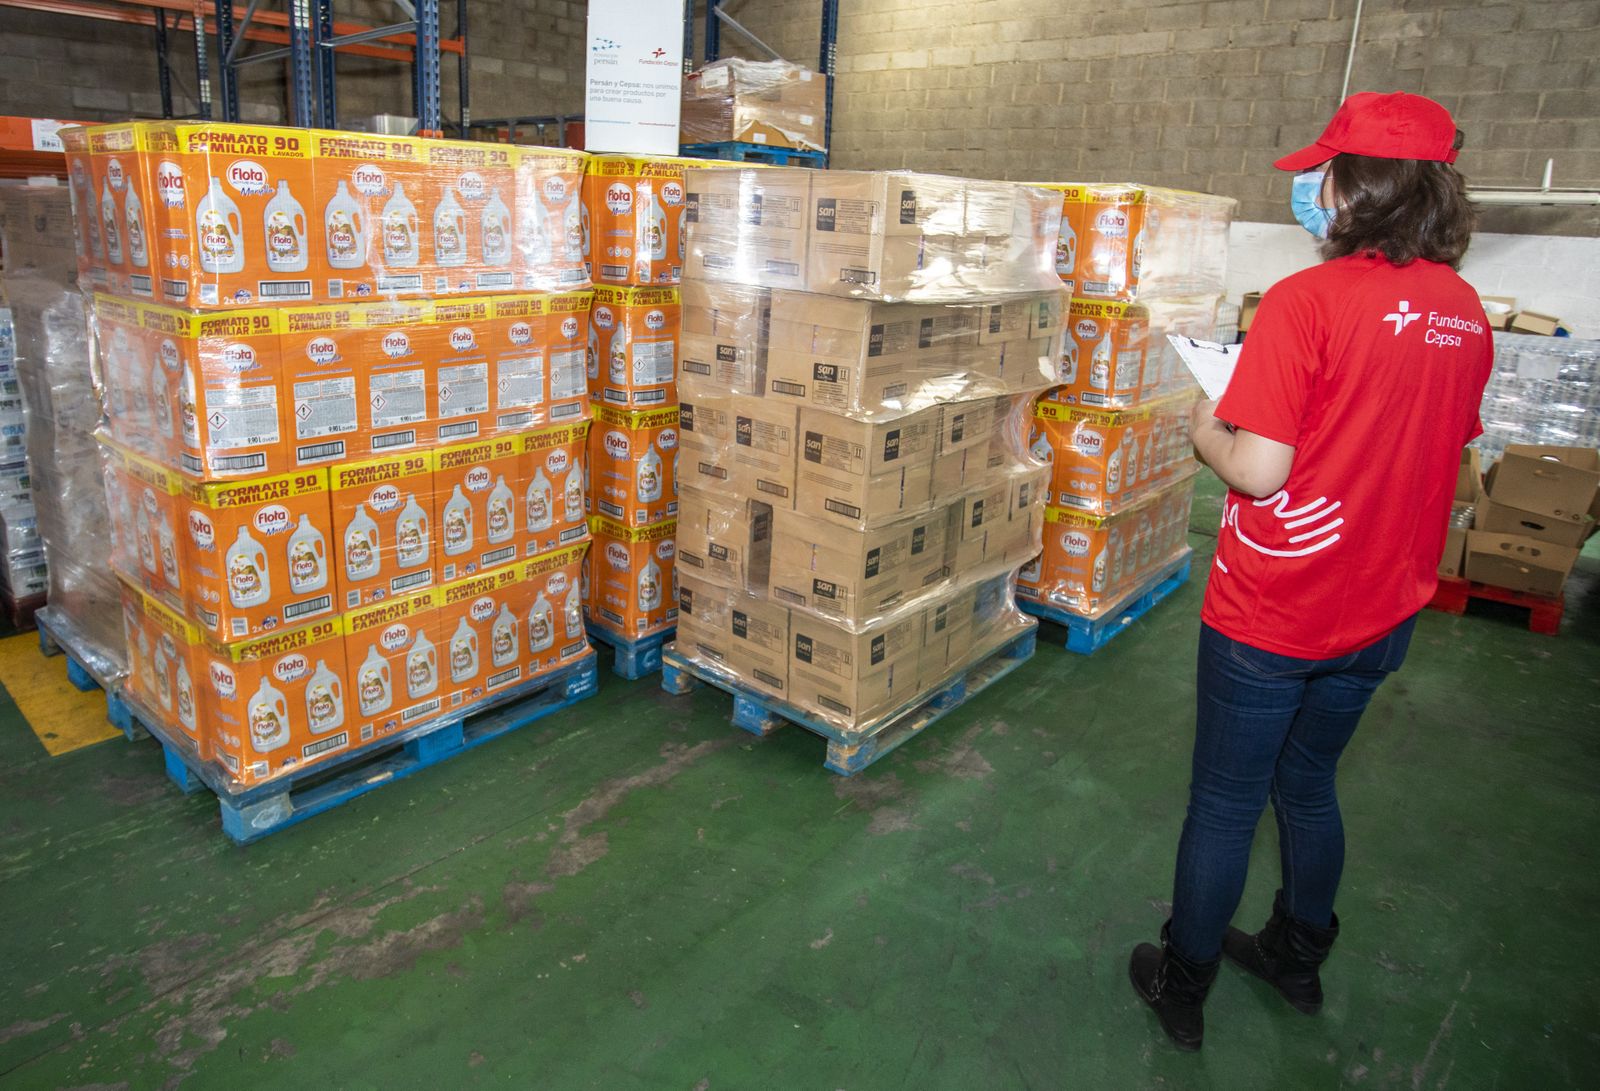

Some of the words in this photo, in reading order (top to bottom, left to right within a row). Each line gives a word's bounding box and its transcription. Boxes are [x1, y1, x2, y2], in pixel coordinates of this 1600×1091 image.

[603, 95, 621, 103] buena
[189, 132, 268, 145] FORMATO
[274, 137, 299, 151] 90
[319, 138, 386, 150] FORMATO
[391, 143, 412, 155] 90
[189, 143, 267, 155] FAMILIAR
[490, 151, 507, 162] 90
[232, 168, 262, 181] Flota
[357, 172, 382, 183] Flota
[460, 178, 482, 188] Flota
[608, 190, 630, 201] Flota
[664, 187, 680, 196] Flota
[1065, 189, 1079, 198] 90
[902, 200, 915, 209] san
[818, 207, 834, 217] san
[274, 235, 292, 245] Flota
[633, 291, 661, 300] FORMATO
[663, 291, 673, 300] 90
[496, 301, 529, 310] FORMATO
[531, 301, 542, 310] 90
[551, 297, 579, 306] FORMATO
[580, 297, 589, 306] 90
[474, 304, 485, 314] 90
[496, 308, 528, 316] FAMILIAR
[1106, 306, 1121, 314] 90
[288, 312, 331, 322] FORMATO
[335, 311, 349, 322] 90
[435, 312, 470, 321] FAMILIAR
[201, 317, 249, 329] FORMATO
[253, 316, 269, 328] 90
[289, 322, 332, 332] FAMILIAR
[1078, 323, 1096, 332] Flota
[1428, 311, 1483, 335] Fundación
[201, 326, 249, 336] FAMILIAR
[453, 332, 471, 341] Flota
[511, 328, 529, 337] Flota
[385, 338, 406, 347] Flota
[1425, 329, 1462, 348] Cepsa
[310, 343, 334, 353] Flota
[719, 347, 734, 356] san
[818, 365, 834, 376] san
[639, 411, 678, 422] FORMATO
[681, 410, 693, 418] san
[1042, 408, 1057, 416] 90
[525, 430, 569, 443] FORMATO
[572, 427, 585, 437] 90
[660, 433, 675, 442] Flota
[1076, 433, 1100, 445] Flota
[525, 437, 569, 451] FAMILIAR
[606, 435, 628, 449] Flota
[807, 438, 821, 450] san
[886, 438, 898, 448] san
[440, 445, 492, 462] FORMATO
[496, 442, 512, 453] 90
[440, 454, 491, 469] FAMILIAR
[549, 454, 566, 465] Flota
[339, 462, 400, 479] FORMATO
[405, 458, 424, 470] 90
[340, 470, 399, 488] FAMILIAR
[468, 472, 488, 482] Flota
[218, 480, 289, 499] FORMATO
[294, 474, 317, 488] 90
[218, 488, 289, 507] FAMILIAR
[373, 490, 396, 502] Flota
[259, 510, 285, 524] Flota
[1064, 536, 1087, 547] Flota
[608, 547, 628, 561] Flota
[526, 553, 569, 570] FORMATO
[867, 555, 879, 566] san
[296, 562, 312, 571] Flota
[526, 560, 568, 578] FAMILIAR
[446, 576, 495, 595] FORMATO
[499, 570, 515, 582] 90
[817, 580, 832, 593] san
[446, 584, 495, 604] FAMILIAR
[352, 603, 408, 625] FORMATO
[413, 595, 431, 608] 90
[473, 601, 492, 614] Flota
[353, 609, 409, 632] FAMILIAR
[734, 618, 746, 628] san
[239, 629, 306, 654] FORMATO
[312, 622, 334, 637] 90
[384, 627, 406, 642] Flota
[240, 639, 307, 661] FAMILIAR
[798, 640, 811, 651] san
[277, 657, 306, 672] Flota
